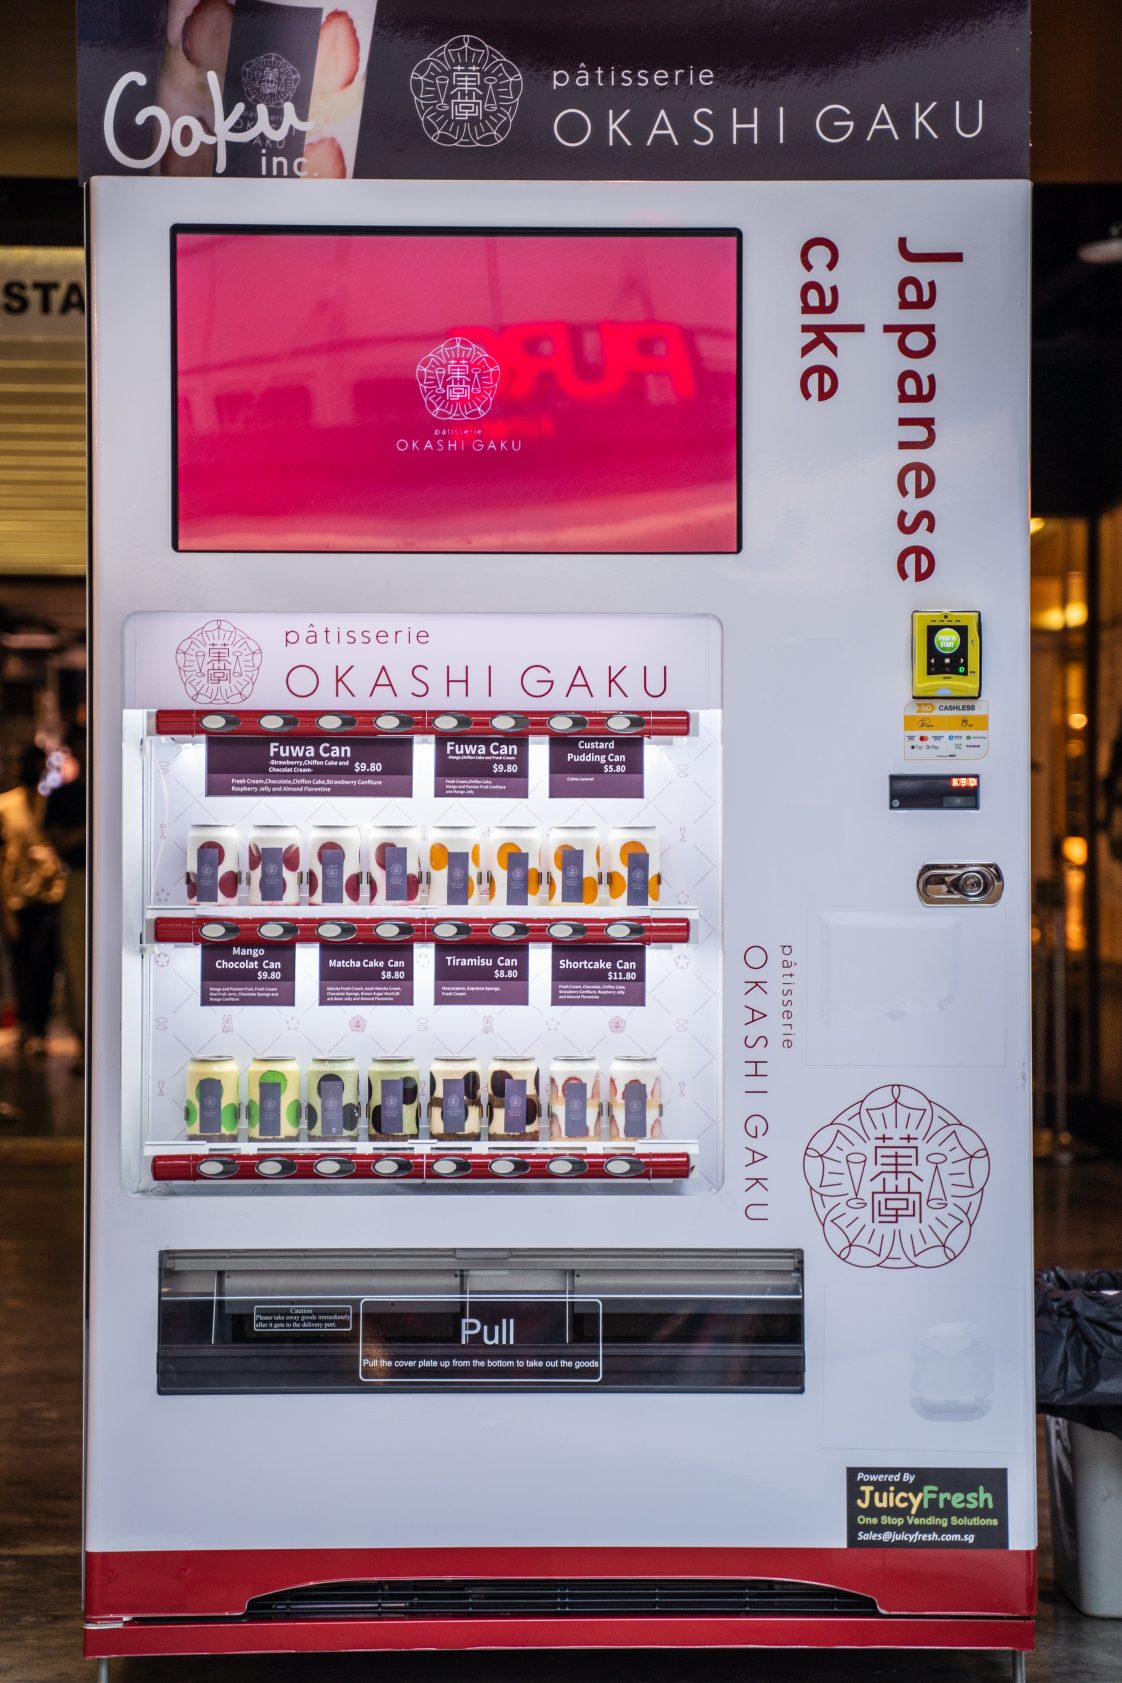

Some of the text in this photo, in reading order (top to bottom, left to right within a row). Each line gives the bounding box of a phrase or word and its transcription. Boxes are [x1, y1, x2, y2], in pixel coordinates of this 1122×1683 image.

[552, 63, 715, 89] pâtisserie
[104, 71, 314, 173] Gaku
[552, 100, 984, 148] OKASHI GAKU
[261, 149, 319, 176] inc.
[800, 236, 865, 402] cake
[882, 236, 964, 582] Japanese
[396, 439, 521, 451] OKASHI GAKU
[285, 624, 430, 647] pâtisserie
[286, 664, 668, 698] OKASHI GAKU
[269, 742, 350, 758] Fuwa Can
[446, 742, 517, 755] Fuwa Can
[578, 740, 614, 749] Custard
[567, 753, 625, 763] Pudding Can
[354, 762, 382, 773] $9.80
[493, 764, 517, 773] $9.80
[604, 764, 625, 773] $5.80
[232, 947, 264, 957] Mango
[216, 960, 281, 969] Chocolat Can
[329, 959, 404, 968] Matcha Cake Can
[446, 956, 517, 966] Tiramisu Can
[559, 960, 636, 969] Shortcake Can
[257, 971, 281, 980] $9.80
[381, 971, 404, 980] $8.80
[494, 970, 518, 978] $8.80
[608, 972, 636, 980] $11.80
[780, 944, 797, 1049] pâtisserie
[744, 945, 768, 1220] OKASHI GAKU
[461, 1319, 514, 1344] Pull
[419, 1360, 438, 1369] plate
[440, 1360, 450, 1369] up
[575, 1360, 599, 1369] goods
[857, 1473, 915, 1483] Powered By
[857, 1486, 993, 1514] JuicyFresh
[857, 1516, 999, 1527] One Stop Vending Solutions
[857, 1531, 975, 1543] Sales@juicyfresh.com.sg
